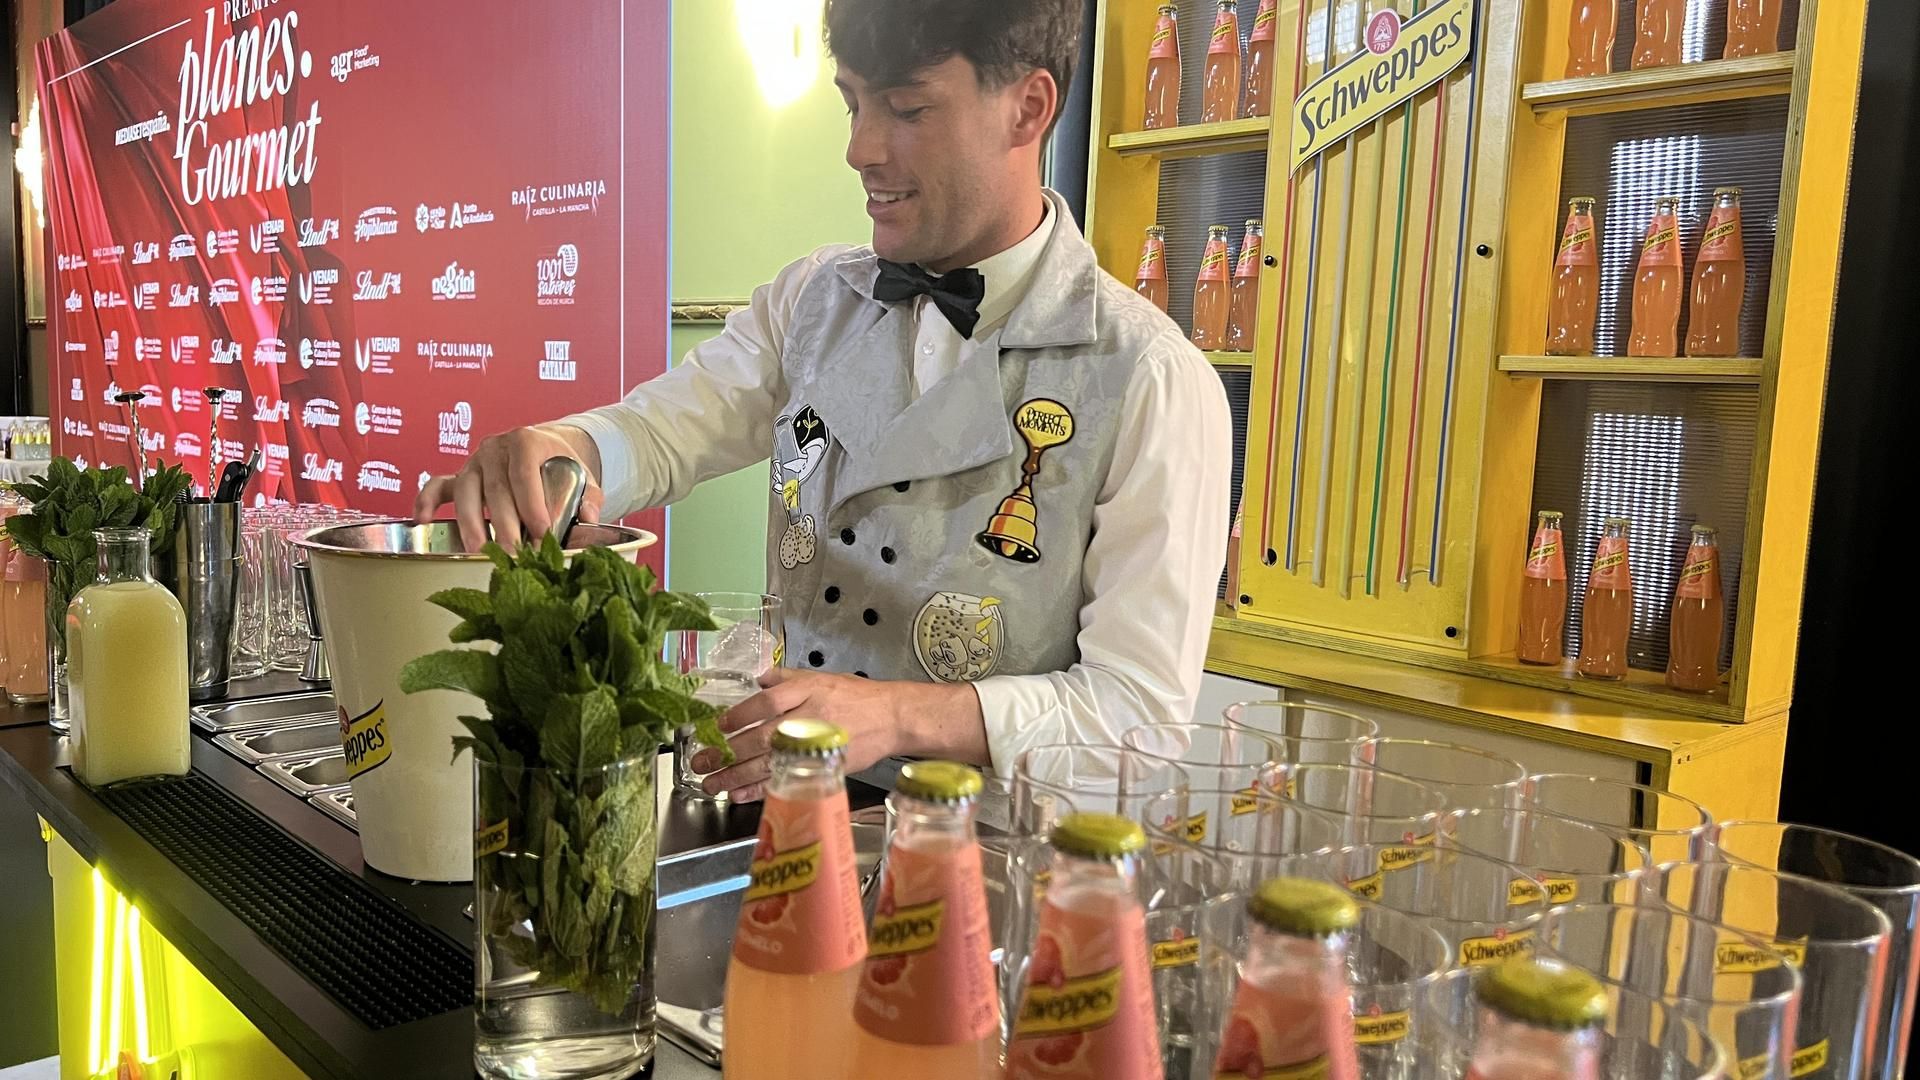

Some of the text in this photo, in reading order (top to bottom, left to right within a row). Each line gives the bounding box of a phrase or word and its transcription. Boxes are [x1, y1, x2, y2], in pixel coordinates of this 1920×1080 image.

[1374, 41, 1390, 52] 1783
[1300, 10, 1462, 156] Schweppes
[180, 100, 322, 206] Gourmet
[512, 179, 606, 206] RAÍZ CULINARIA
[298, 218, 331, 247] Lindt
[352, 270, 392, 300] Lindt
[371, 336, 400, 352] VENARI
[440, 342, 494, 358] CULINARIA
[544, 341, 570, 360] VICHY
[539, 361, 576, 380] CATALAN
[1019, 416, 1066, 436] MOMENTS
[1026, 407, 1070, 425] PERFECT
[301, 453, 335, 482] Lindt
